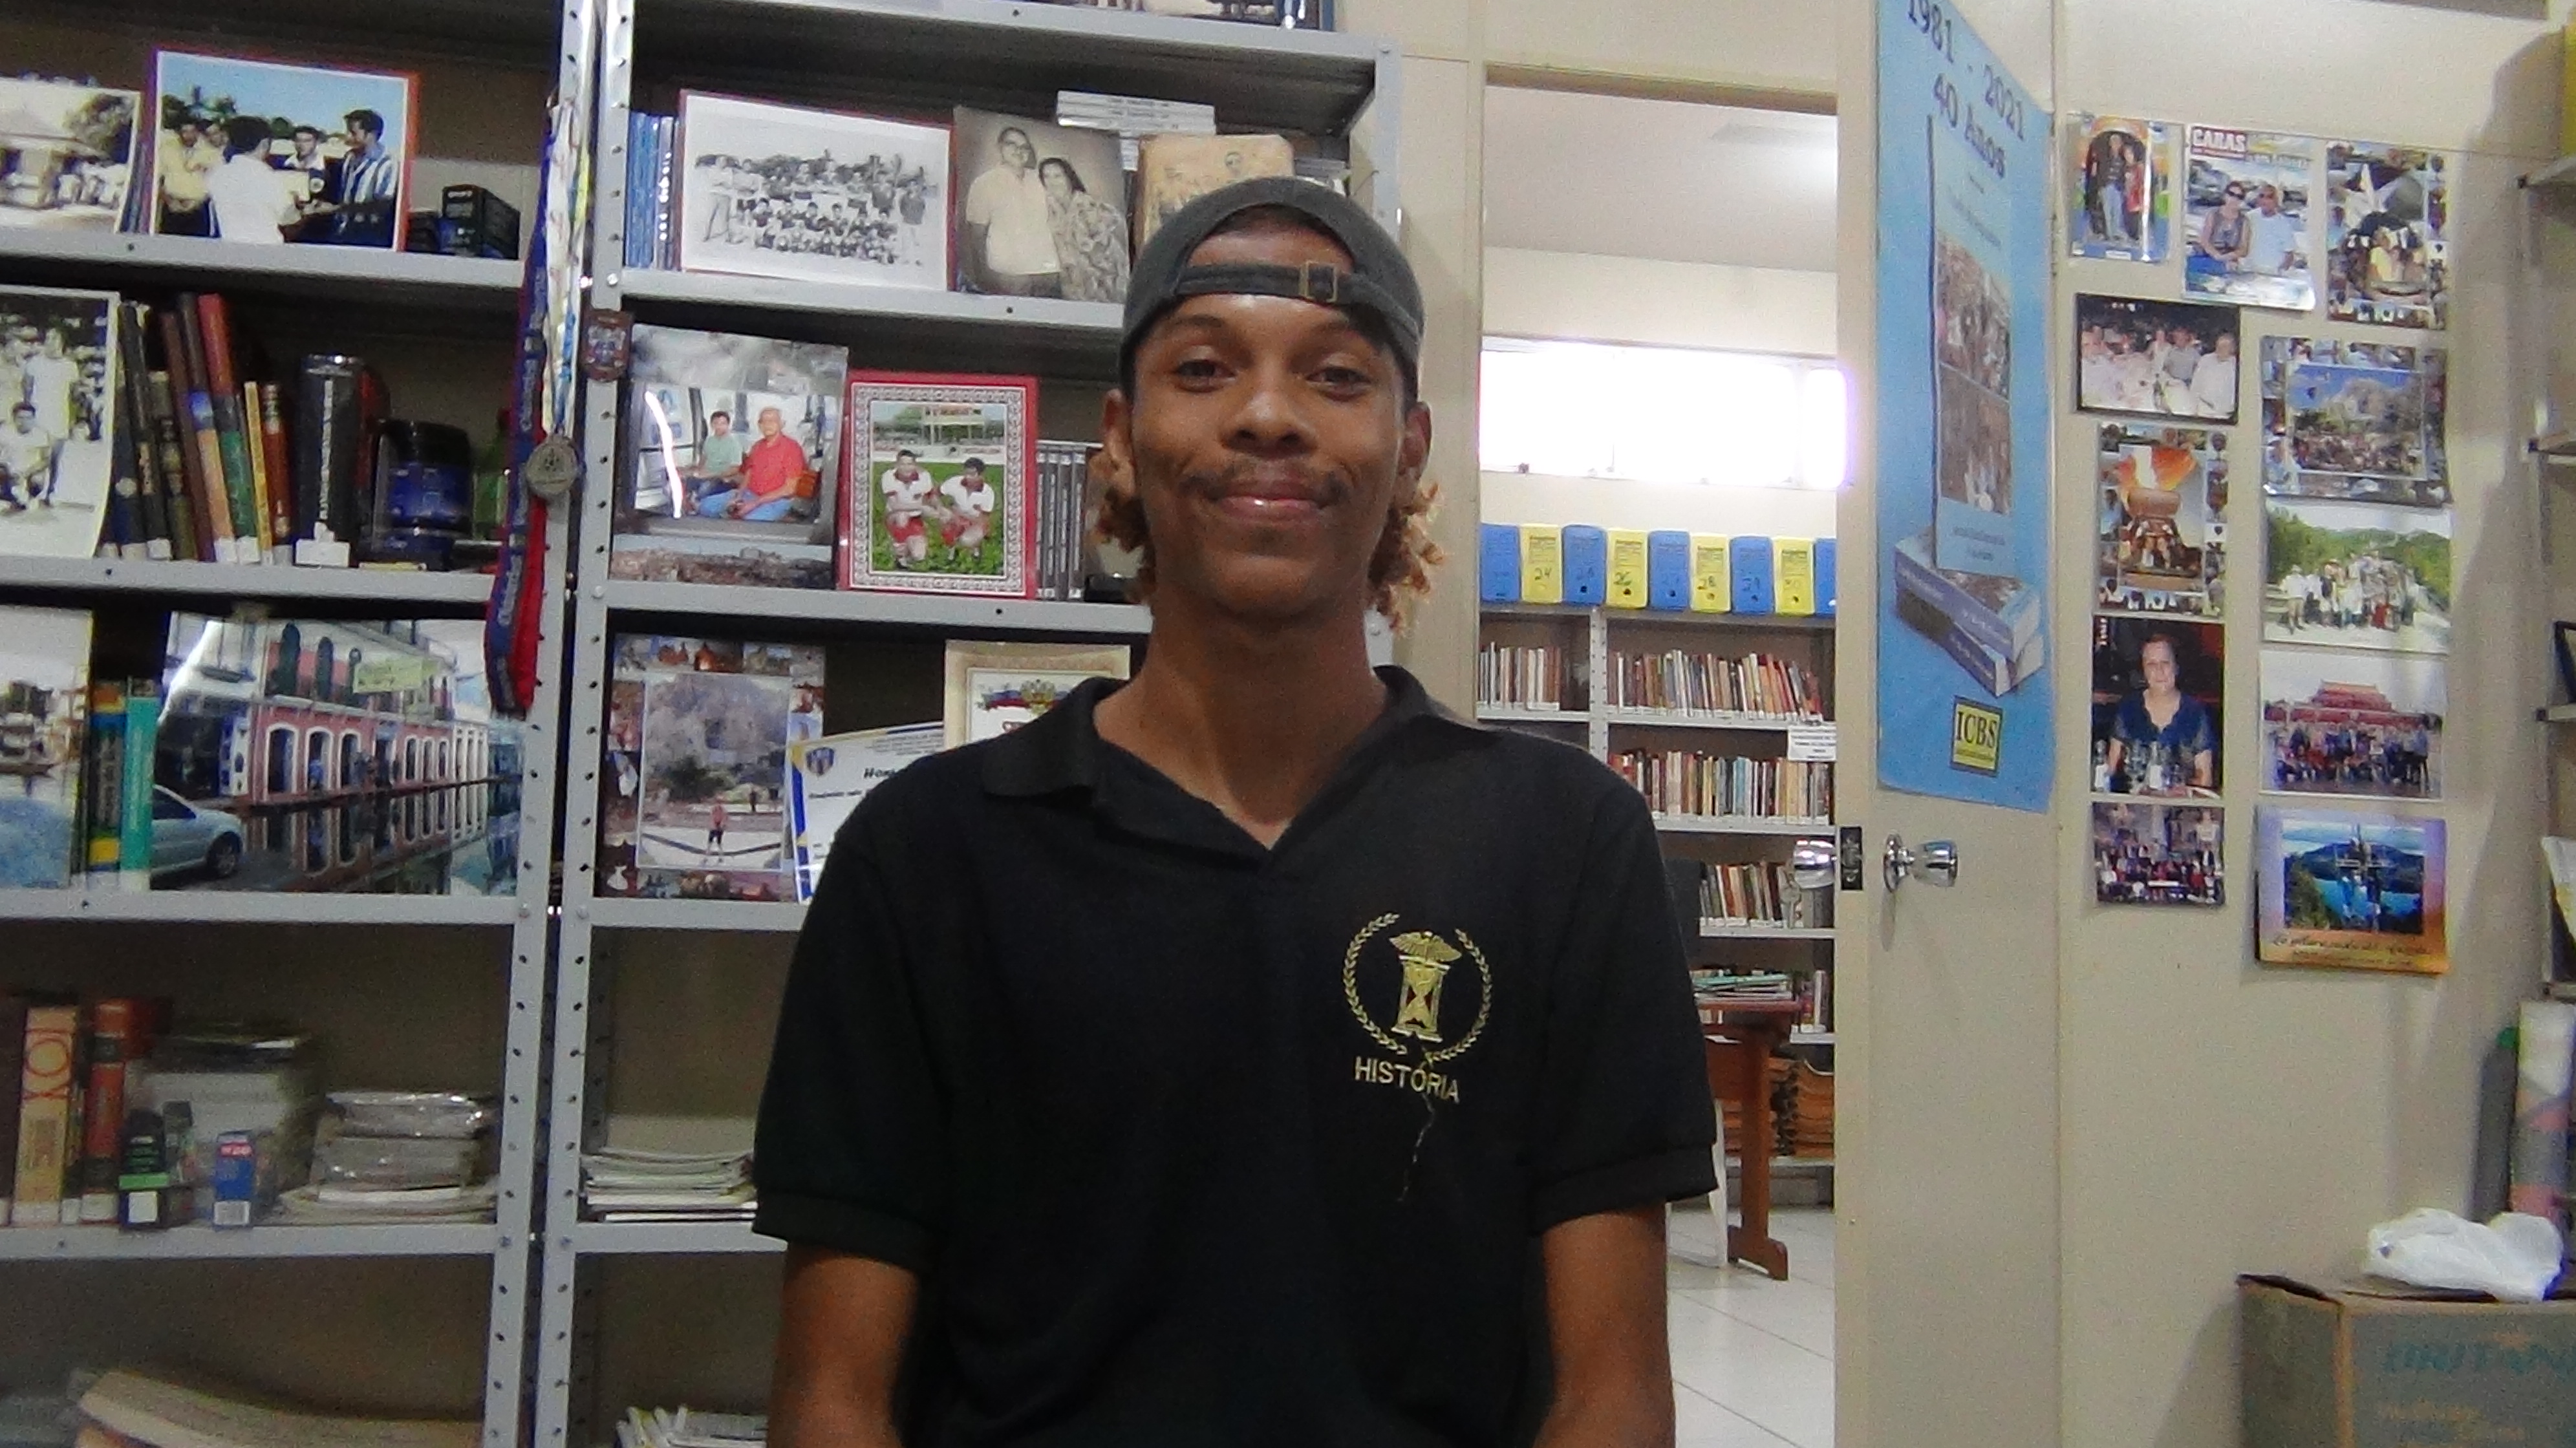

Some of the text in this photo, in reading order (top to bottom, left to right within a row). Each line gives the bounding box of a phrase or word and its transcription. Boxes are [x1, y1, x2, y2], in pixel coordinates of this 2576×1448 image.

[1934, 73, 1957, 128] 40
[1983, 63, 2024, 142] 2021
[2193, 128, 2247, 153] CARAS
[1957, 710, 1997, 748] ICBS
